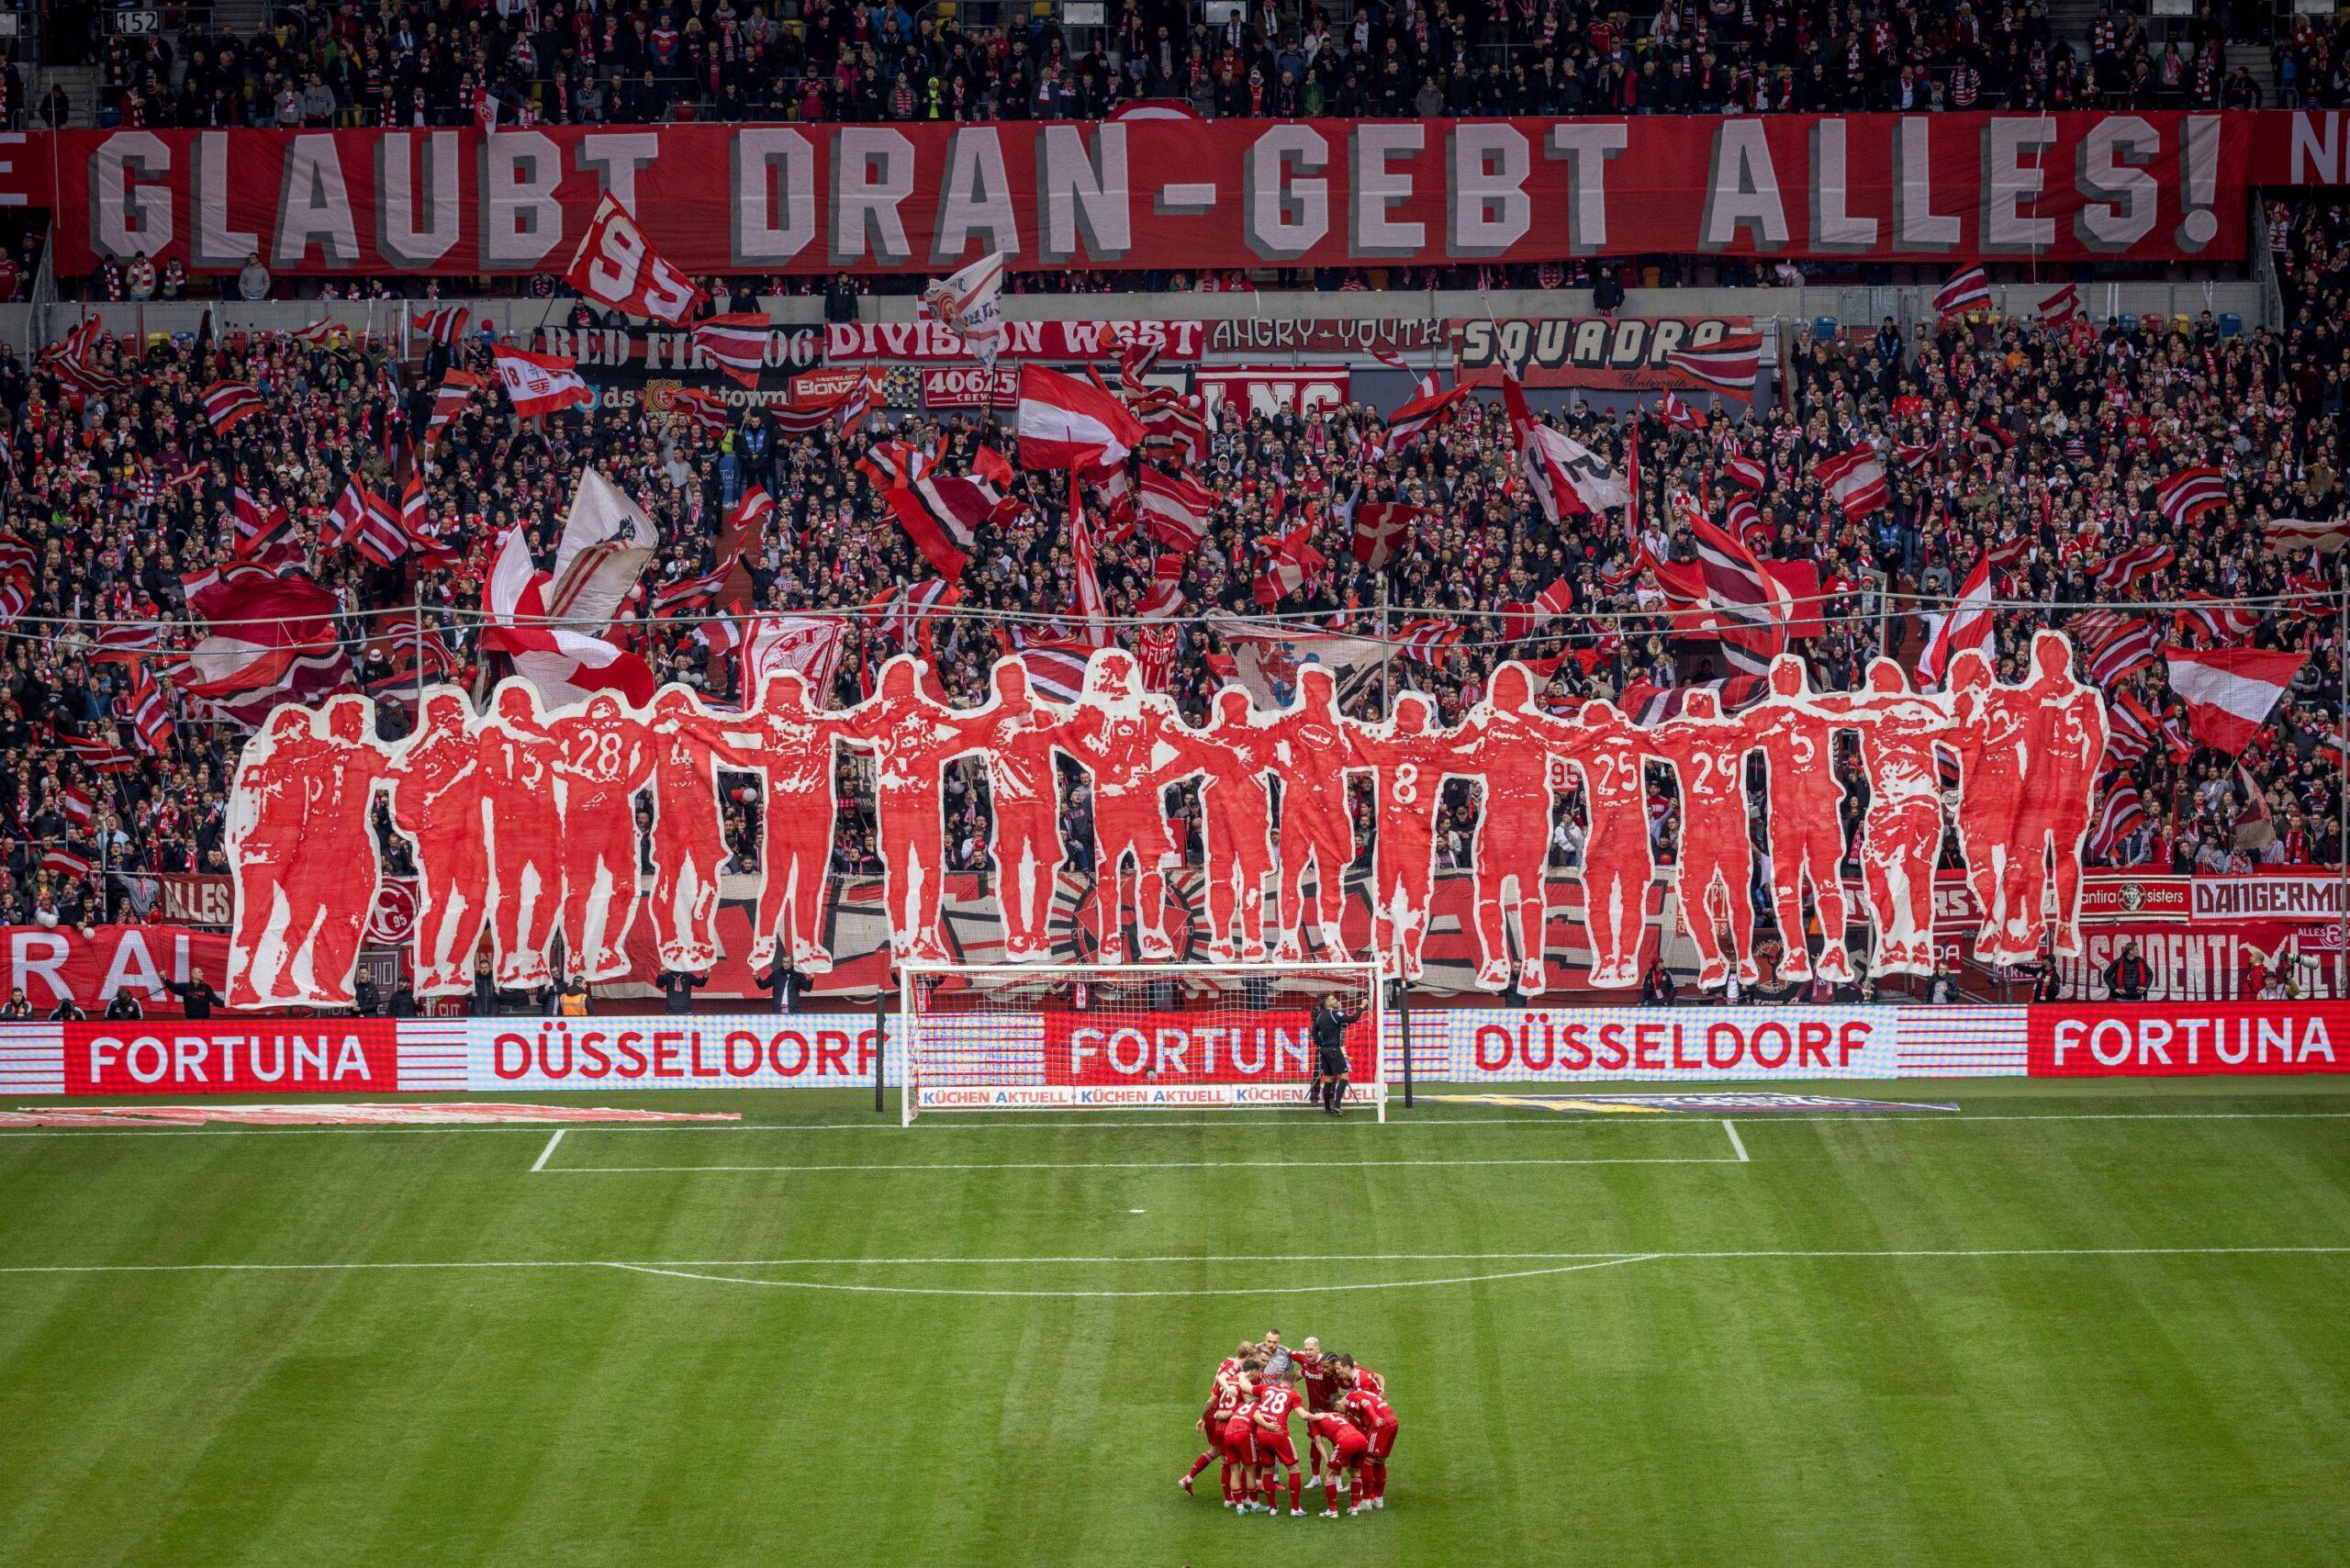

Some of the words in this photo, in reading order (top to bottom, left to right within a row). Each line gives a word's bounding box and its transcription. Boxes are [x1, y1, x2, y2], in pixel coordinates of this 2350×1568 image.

[118, 11, 157, 33] 152
[89, 129, 659, 270] GLAUBT
[731, 122, 1132, 267] DRAN
[1244, 122, 1628, 261] GEBT
[1698, 114, 2222, 255] ALLES!
[589, 214, 695, 321] 95
[543, 326, 631, 367] RED
[763, 328, 815, 368] 06
[1337, 319, 1450, 348] YOUTH
[797, 377, 883, 396] BONZN
[926, 371, 1016, 394] 40625
[956, 393, 990, 402] CREW
[578, 730, 623, 777] 28
[1790, 724, 1815, 763] 5
[1393, 763, 1418, 804] 8
[1551, 762, 1580, 786] 95
[1594, 751, 1638, 795] 25
[1690, 752, 1737, 794] 29
[164, 880, 230, 924] ALLES
[2081, 890, 2117, 904] antira
[2146, 889, 2184, 903] sisters
[2298, 927, 2326, 937] ALLES
[90, 1035, 372, 1084] FORTUNA
[494, 1021, 890, 1080] DÜSSELDORF
[1070, 1025, 1313, 1075] FORTUN
[1475, 1013, 1874, 1071] DÜSSELDORF
[2053, 1016, 2336, 1067] FORTUNA
[923, 1087, 990, 1104] KÜCHEN
[995, 1090, 1068, 1103] AKTUELL
[1081, 1087, 1149, 1104] KÜCHEN
[1153, 1090, 1225, 1103] AKTUELL
[1236, 1086, 1306, 1103] KÜCHEN
[1304, 1371, 1324, 1381] Persil
[1260, 1389, 1288, 1415] 28
